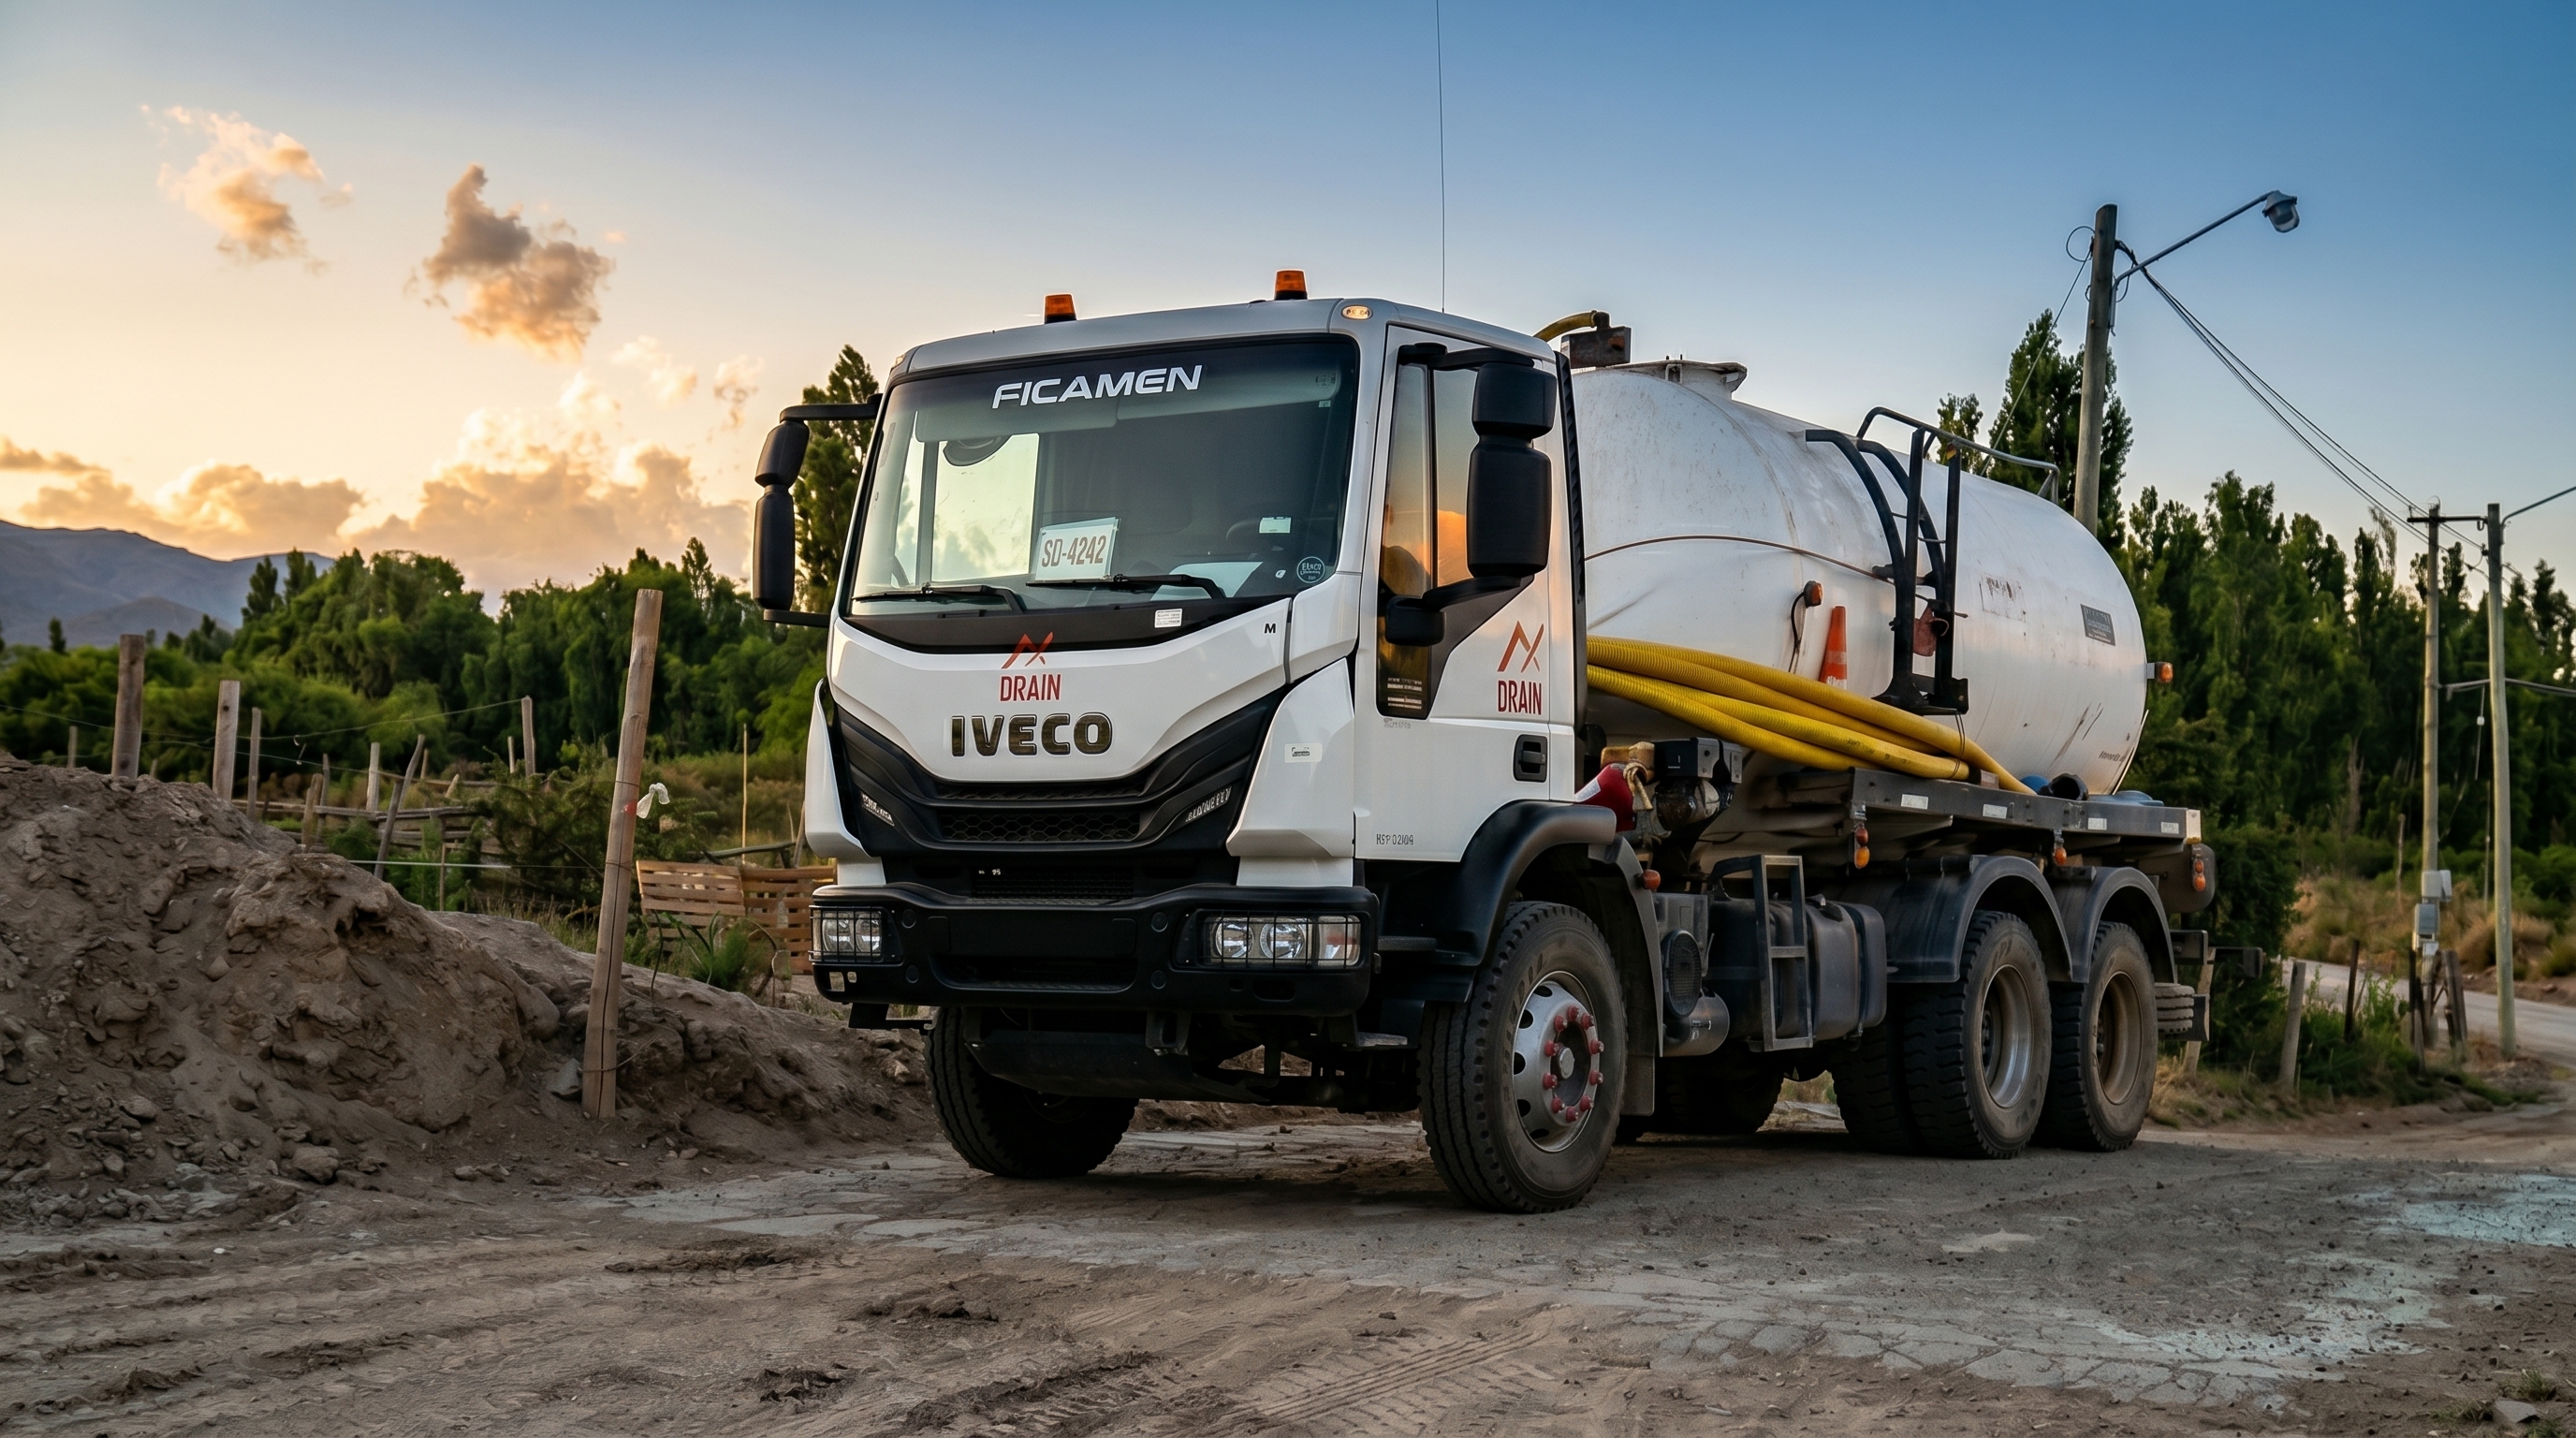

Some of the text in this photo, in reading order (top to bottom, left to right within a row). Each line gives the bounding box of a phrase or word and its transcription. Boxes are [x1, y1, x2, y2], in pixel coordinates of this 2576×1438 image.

[992, 365, 1203, 409] FICAMEN
[1041, 535, 1107, 568] SD-4242
[1264, 623, 1277, 634] M
[1000, 673, 1061, 701] DRAIN
[1498, 680, 1542, 715] DRAIN
[951, 712, 1112, 756] IVECO
